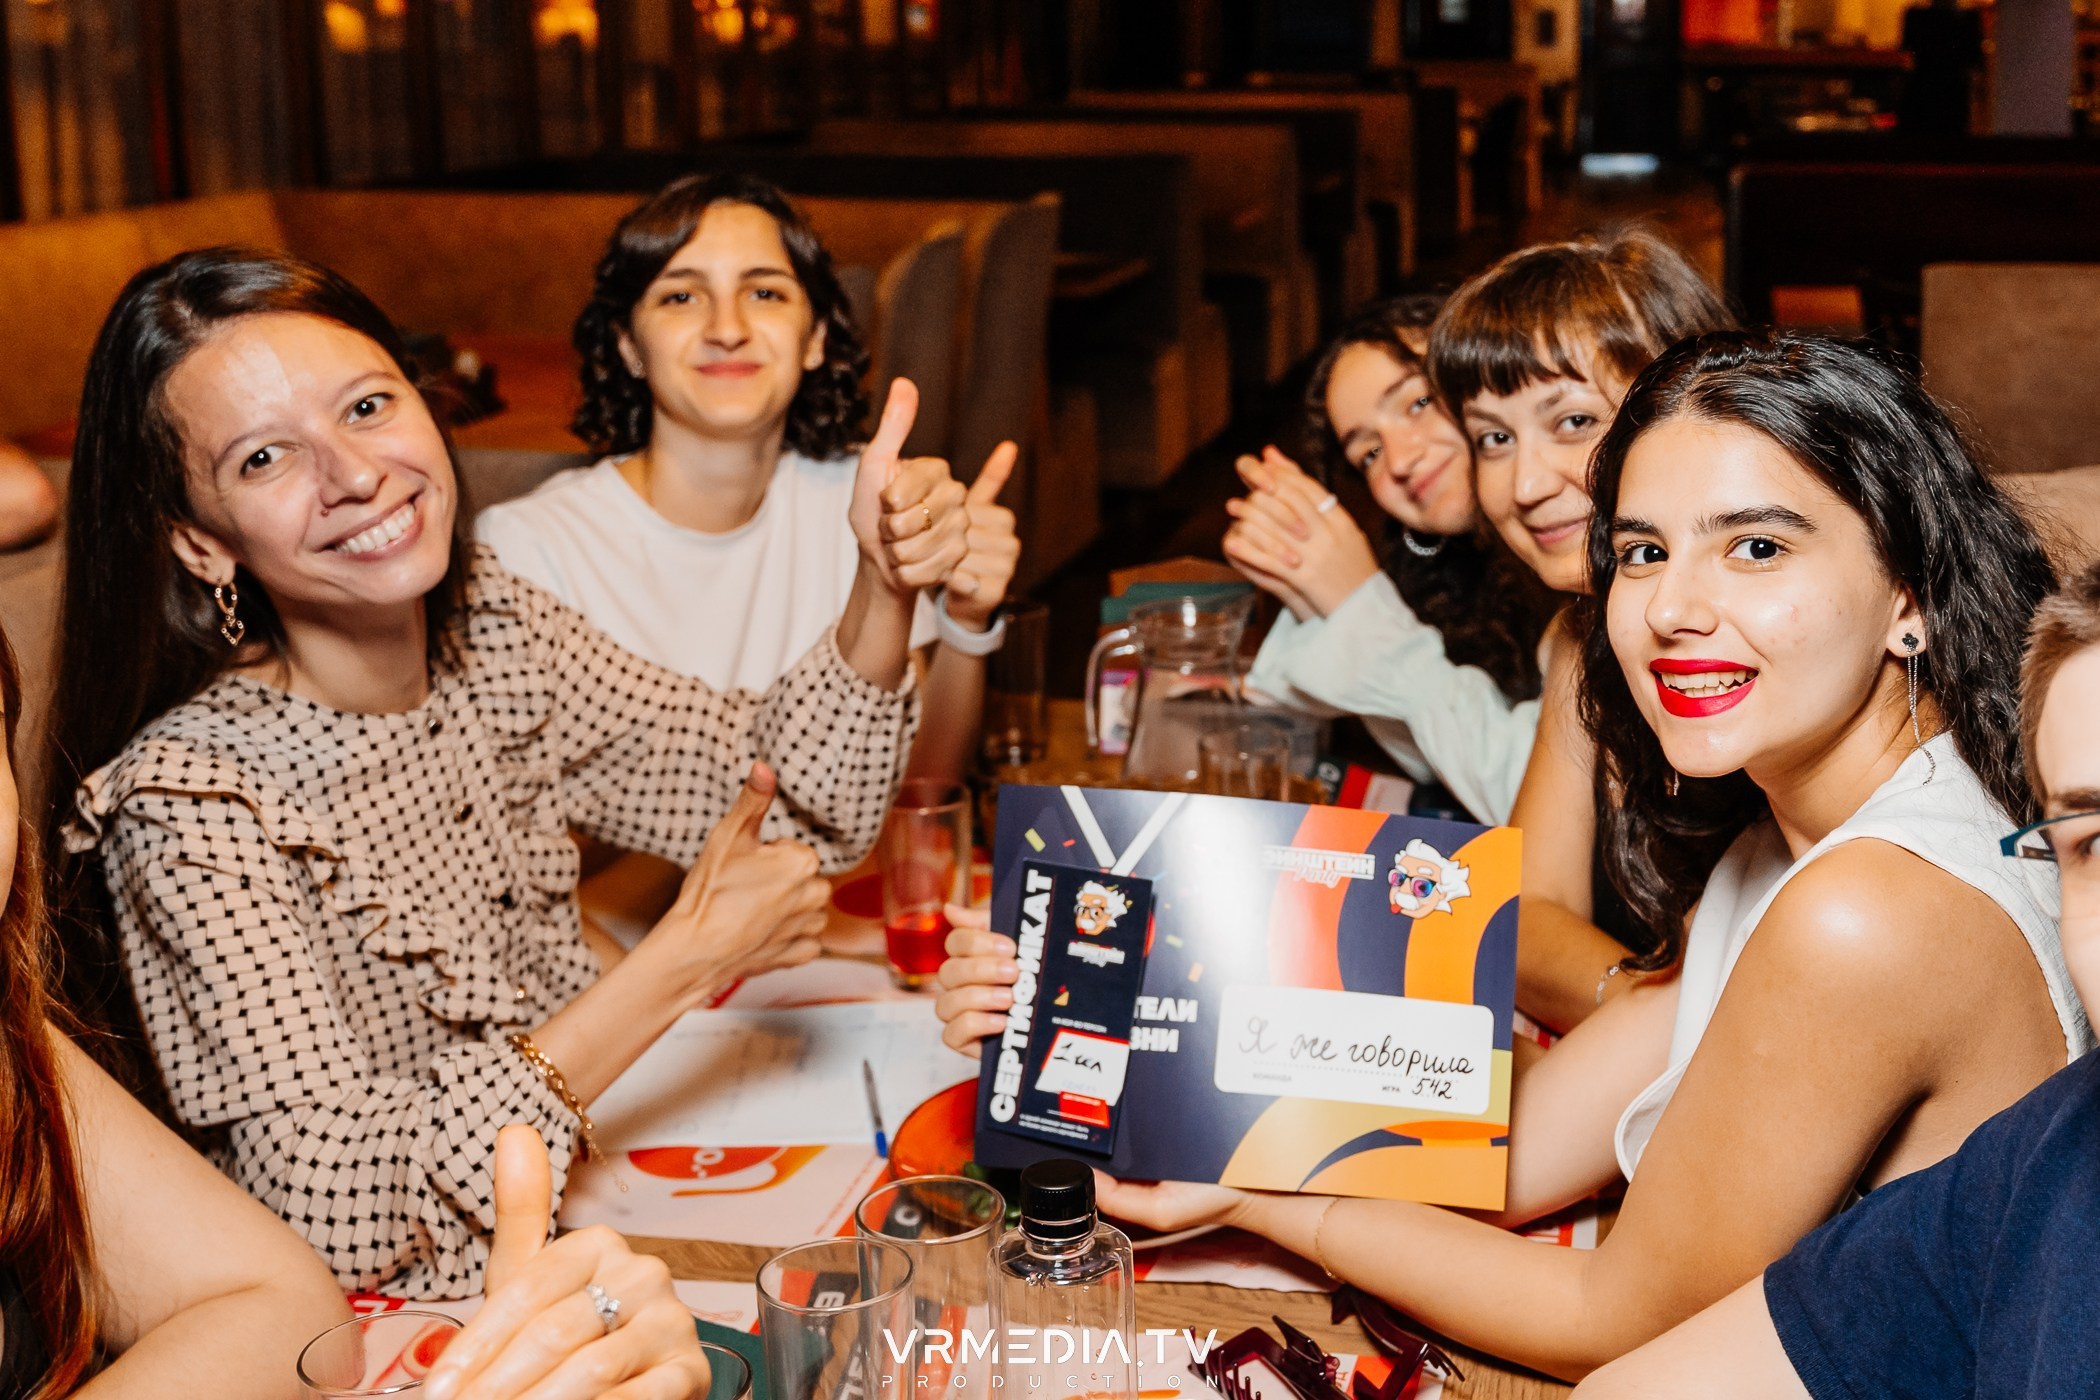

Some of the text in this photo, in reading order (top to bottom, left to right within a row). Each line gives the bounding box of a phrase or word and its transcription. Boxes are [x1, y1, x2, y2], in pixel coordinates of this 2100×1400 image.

[990, 869, 1053, 1122] СЕРТИФИКАТ
[1239, 1016, 1474, 1076] Я же говорила
[1382, 1085, 1401, 1093] ИГРА
[1412, 1078, 1452, 1099] 542
